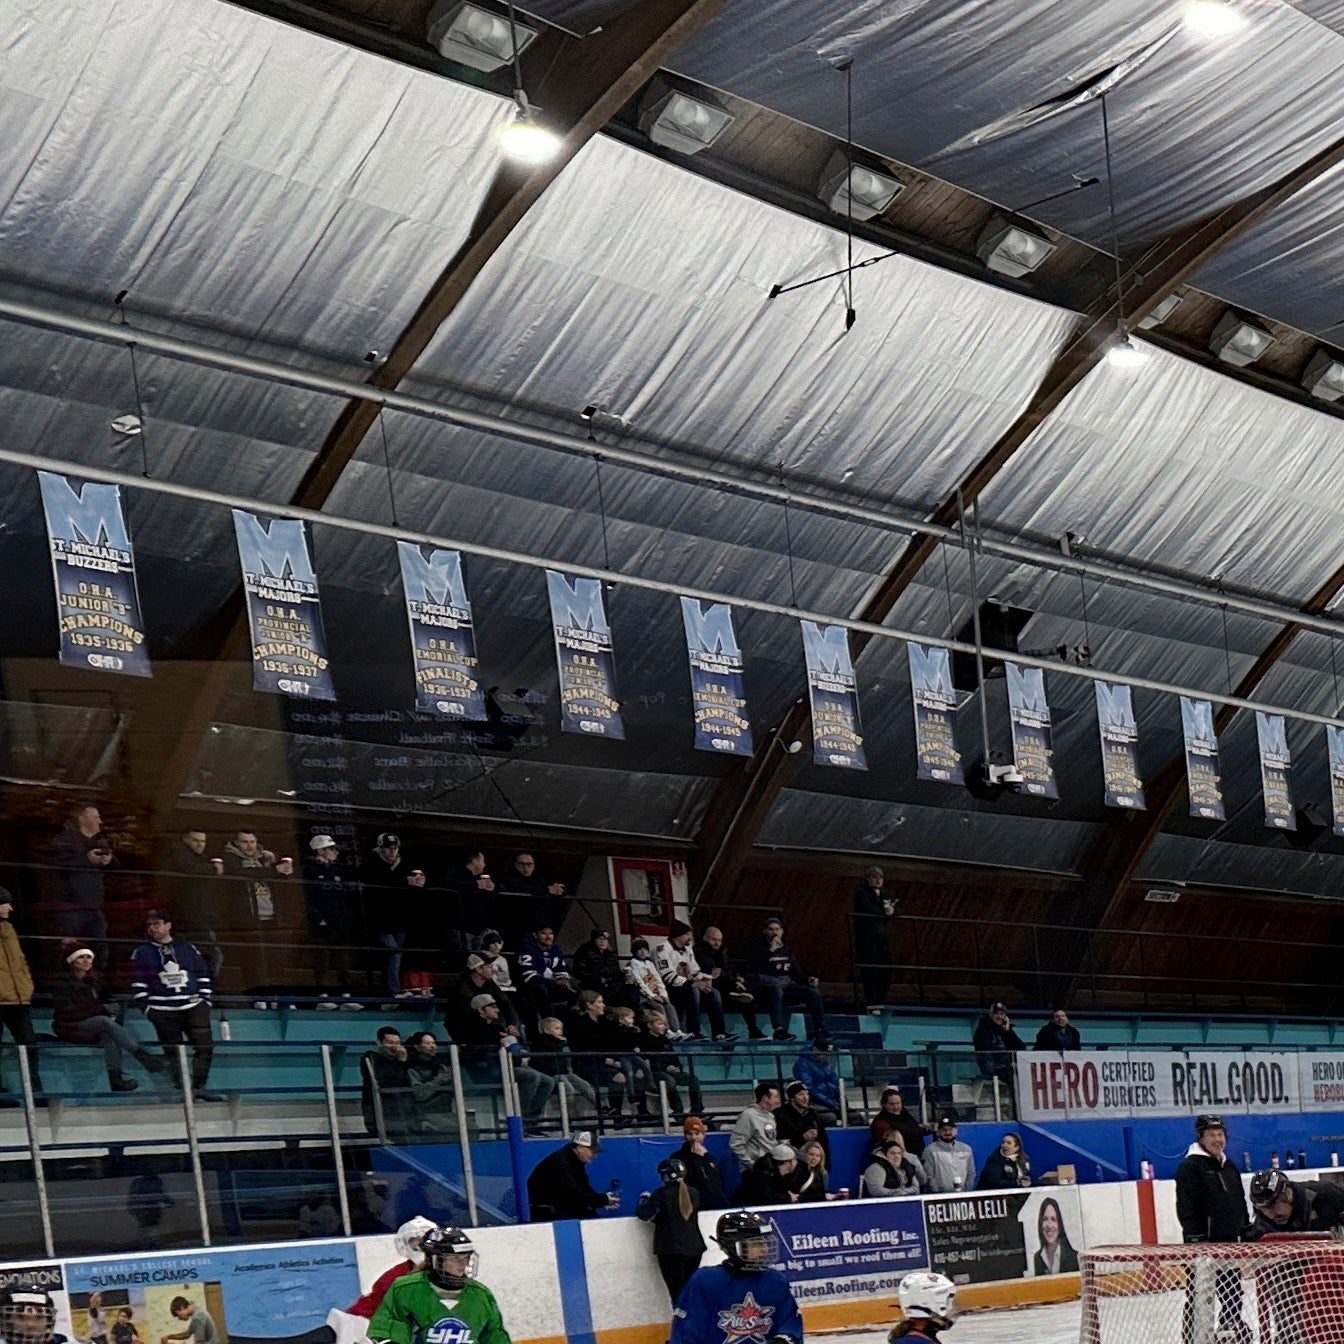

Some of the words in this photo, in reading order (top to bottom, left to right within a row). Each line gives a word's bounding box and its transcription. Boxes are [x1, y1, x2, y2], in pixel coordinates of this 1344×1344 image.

[71, 541, 131, 564] MICHAEL'S
[66, 553, 119, 574] BUZZERS
[257, 586, 302, 604] MAJORS
[260, 575, 315, 595] MICHAEL'S
[60, 594, 110, 612] JUNIOR
[60, 614, 145, 644] CHAMPIONS
[253, 642, 329, 671] CHAMPIONS
[416, 649, 459, 664] EMORIAL
[1311, 1061, 1335, 1081] HERO
[1030, 1061, 1099, 1110] HERO
[928, 1201, 976, 1224] BELINDA
[978, 1198, 1008, 1219] LELLI
[790, 1233, 839, 1251] Eileen
[841, 1228, 900, 1246] Roofing
[901, 1230, 920, 1241] Inc.
[234, 1263, 276, 1273] Academics
[278, 1259, 311, 1268] Athletics
[787, 1259, 804, 1272] big
[805, 1258, 816, 1268] to
[818, 1255, 843, 1267] small
[844, 1255, 860, 1264] we
[861, 1252, 881, 1264] roof
[882, 1249, 907, 1260] them
[90, 1271, 150, 1288] SUMMER
[152, 1267, 200, 1283] CAMPS
